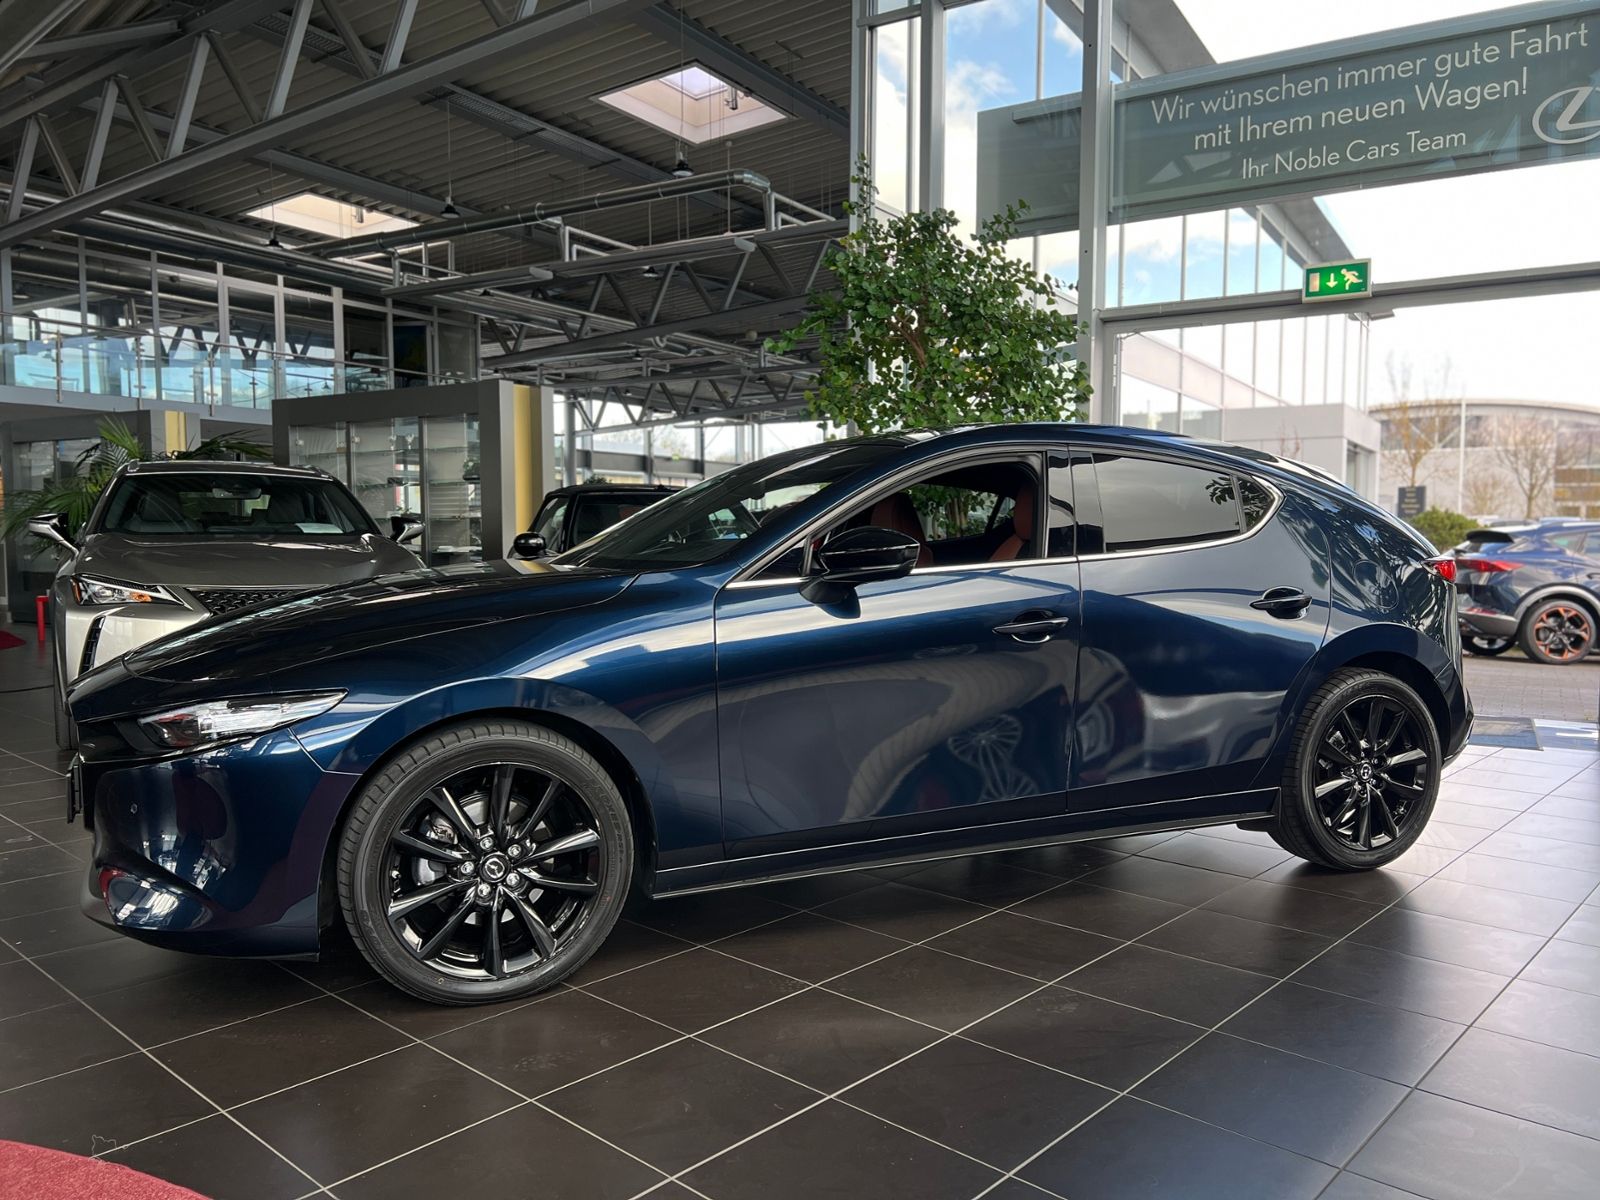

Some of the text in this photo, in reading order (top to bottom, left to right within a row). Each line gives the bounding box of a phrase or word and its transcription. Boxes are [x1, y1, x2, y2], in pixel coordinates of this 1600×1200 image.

[1151, 23, 1588, 124] Wir wünschen immer gute Fahrt
[1194, 66, 1527, 150] mit Ihrem neuen Wagen!
[1243, 130, 1466, 179] Ihr Noble Cars Team
